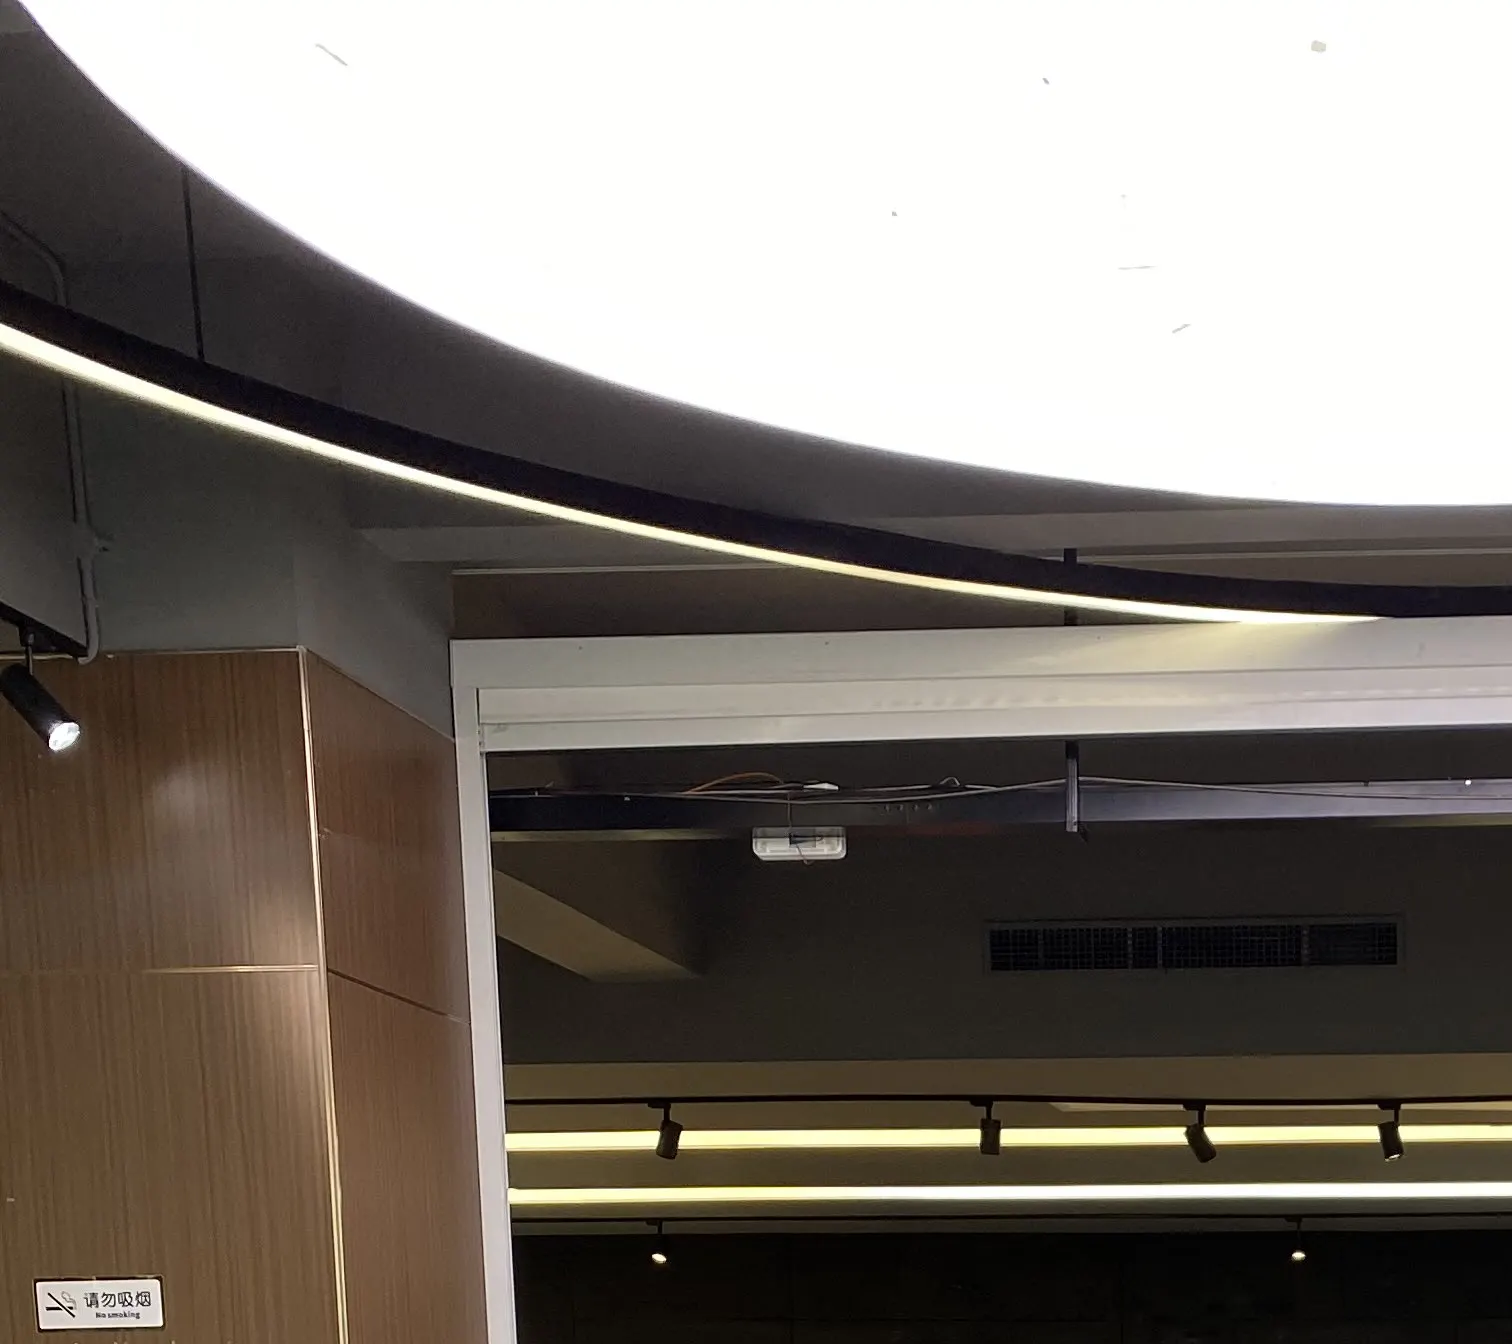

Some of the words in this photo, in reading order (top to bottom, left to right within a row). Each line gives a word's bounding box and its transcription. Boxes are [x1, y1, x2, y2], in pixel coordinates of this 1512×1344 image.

[84, 1291, 151, 1308] 请勿吸烟
[107, 1311, 141, 1319] smoking
